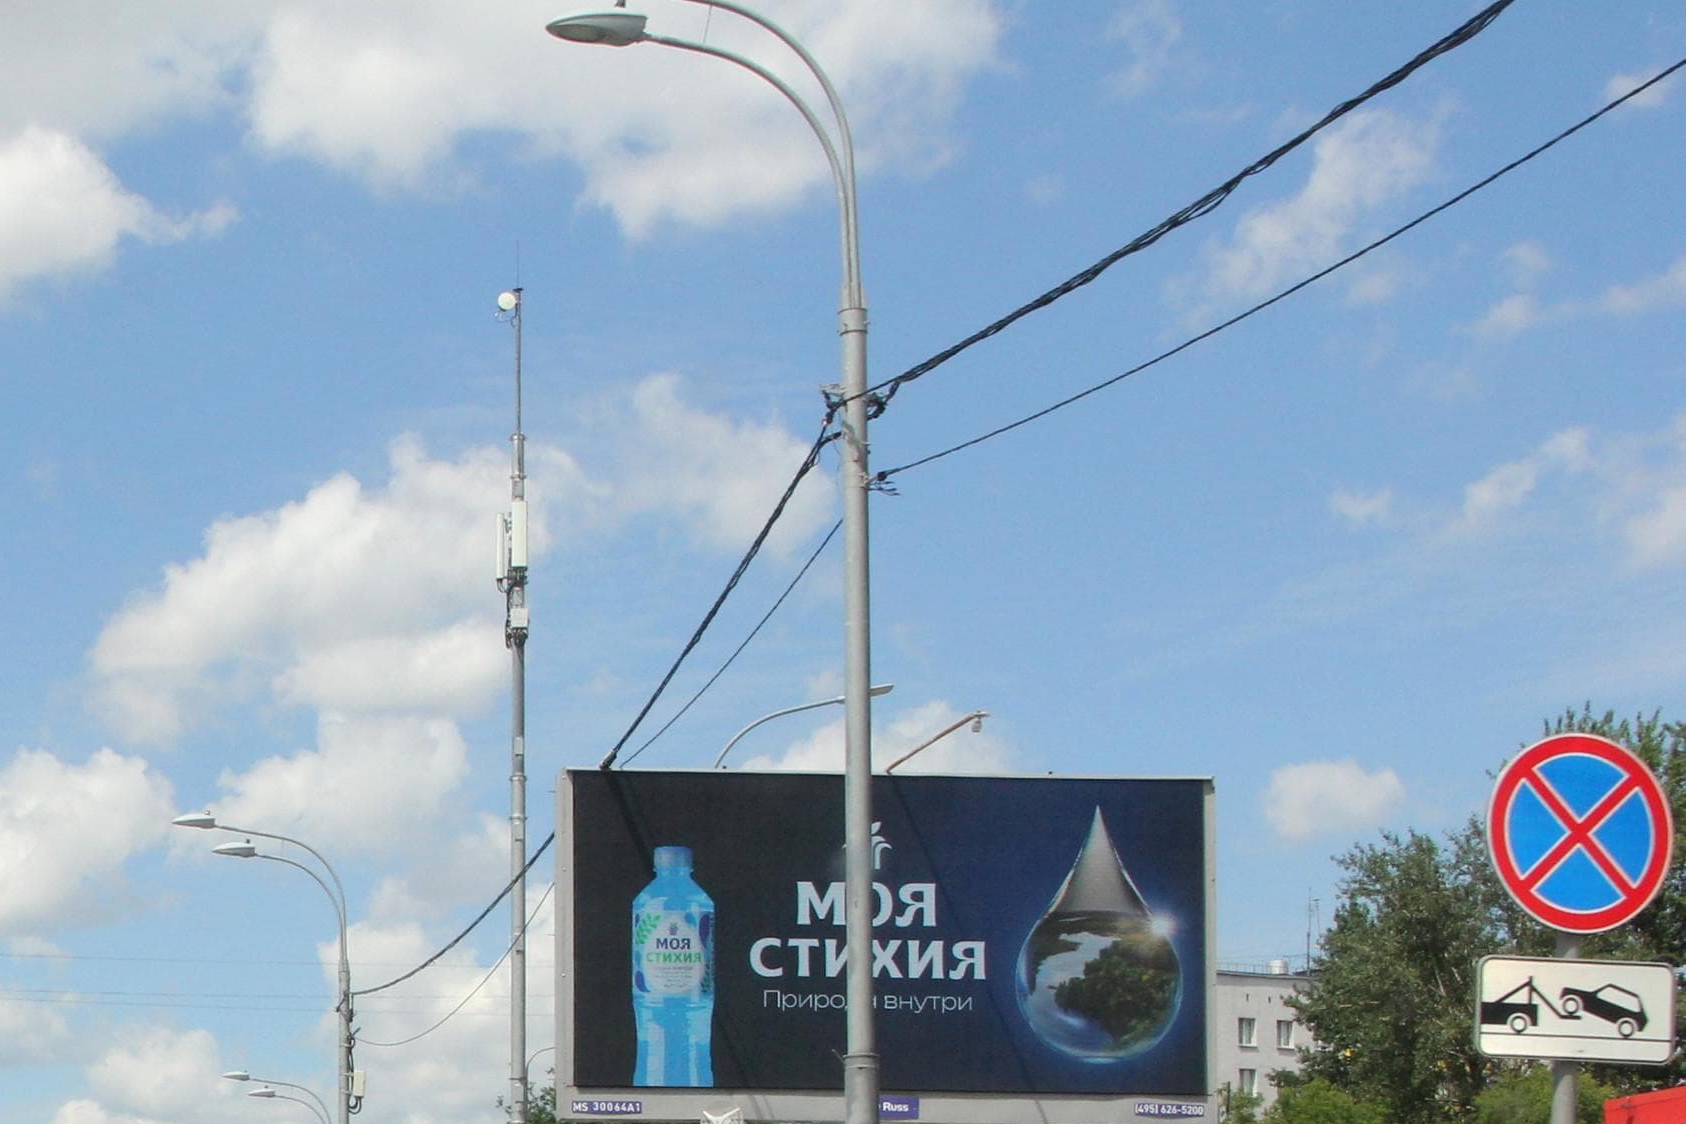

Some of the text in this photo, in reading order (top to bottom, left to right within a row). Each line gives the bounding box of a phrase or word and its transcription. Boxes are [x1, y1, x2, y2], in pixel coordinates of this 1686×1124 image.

[656, 937, 691, 950] МОЯ
[646, 952, 702, 963] СТИХИЯ
[749, 937, 987, 980] СТИХИЯ
[763, 989, 973, 1014] Приро внутри
[573, 1102, 641, 1113] MS 30064A1
[882, 1101, 909, 1112] Russ
[1160, 1104, 1204, 1115] 626-5200
